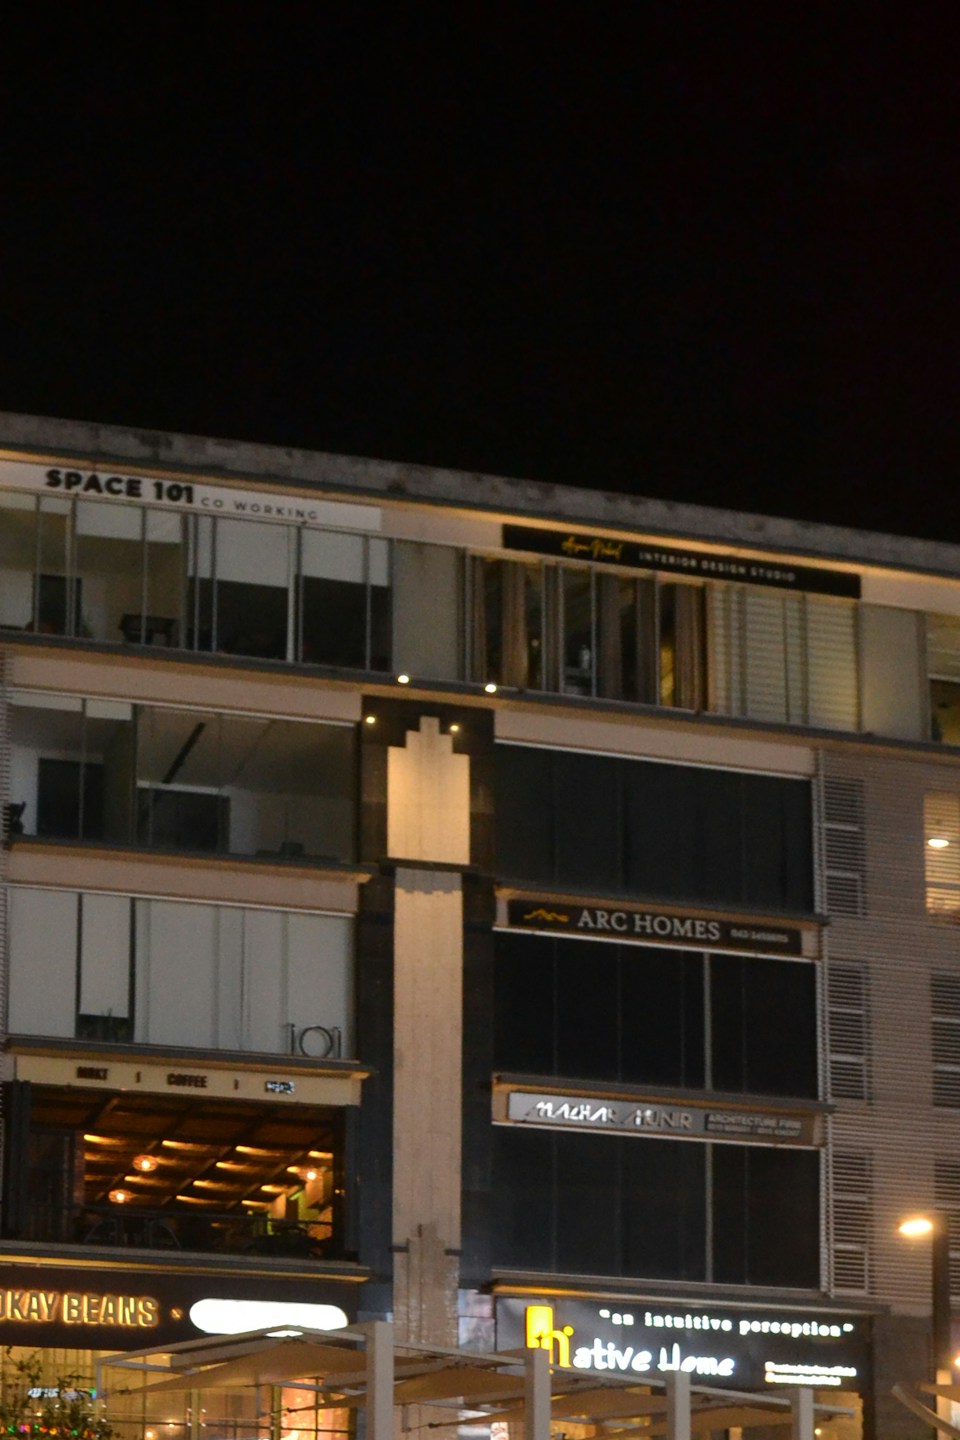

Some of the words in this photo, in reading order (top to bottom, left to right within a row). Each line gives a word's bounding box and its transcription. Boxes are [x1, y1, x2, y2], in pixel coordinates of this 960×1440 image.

[45, 469, 143, 498] SPACE
[153, 481, 195, 504] 101
[201, 497, 224, 508] CO
[234, 501, 318, 520] WORKING
[639, 552, 698, 568] INTERIOR
[701, 559, 746, 575] DESIGN
[750, 566, 796, 582] STUDIO
[577, 909, 628, 931] ARC
[634, 915, 721, 941] HOMES
[167, 1073, 208, 1088] COFFEE
[63, 1292, 159, 1328] BEANS
[644, 1311, 733, 1331] intuitive
